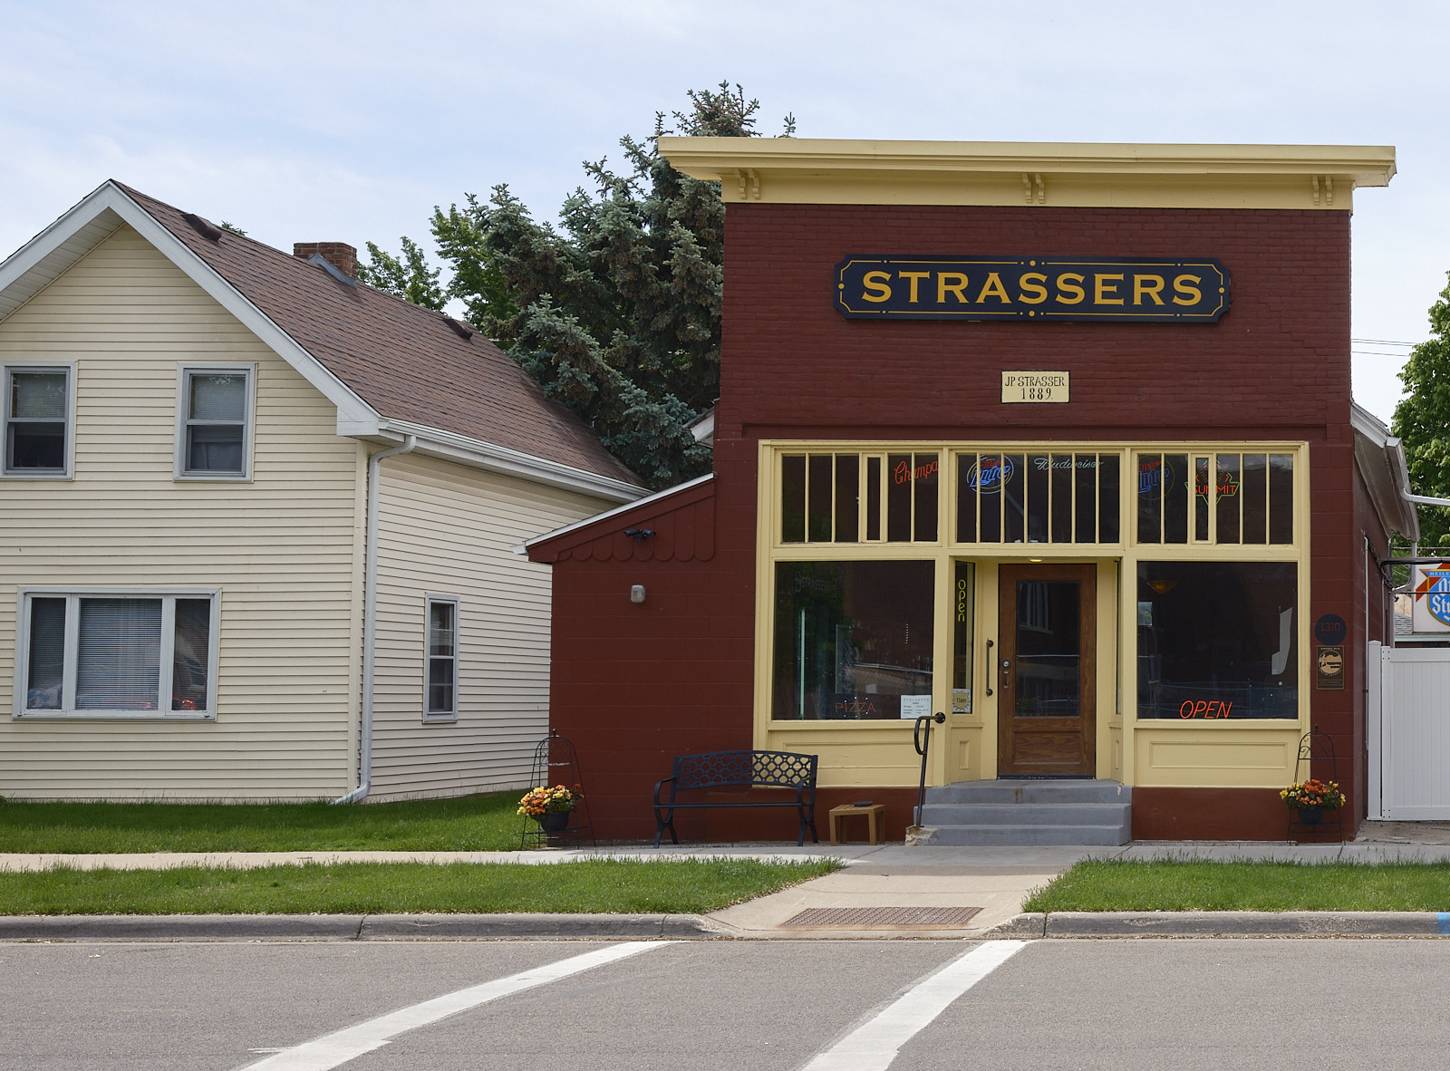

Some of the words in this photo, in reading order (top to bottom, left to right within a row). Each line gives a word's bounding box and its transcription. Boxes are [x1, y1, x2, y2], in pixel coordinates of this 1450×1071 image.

[861, 270, 1203, 306] STRASSERS
[1005, 376, 1016, 387] JP
[1017, 376, 1065, 387] STRASSER
[1022, 388, 1052, 400] 1889
[1179, 700, 1233, 719] OPEN
